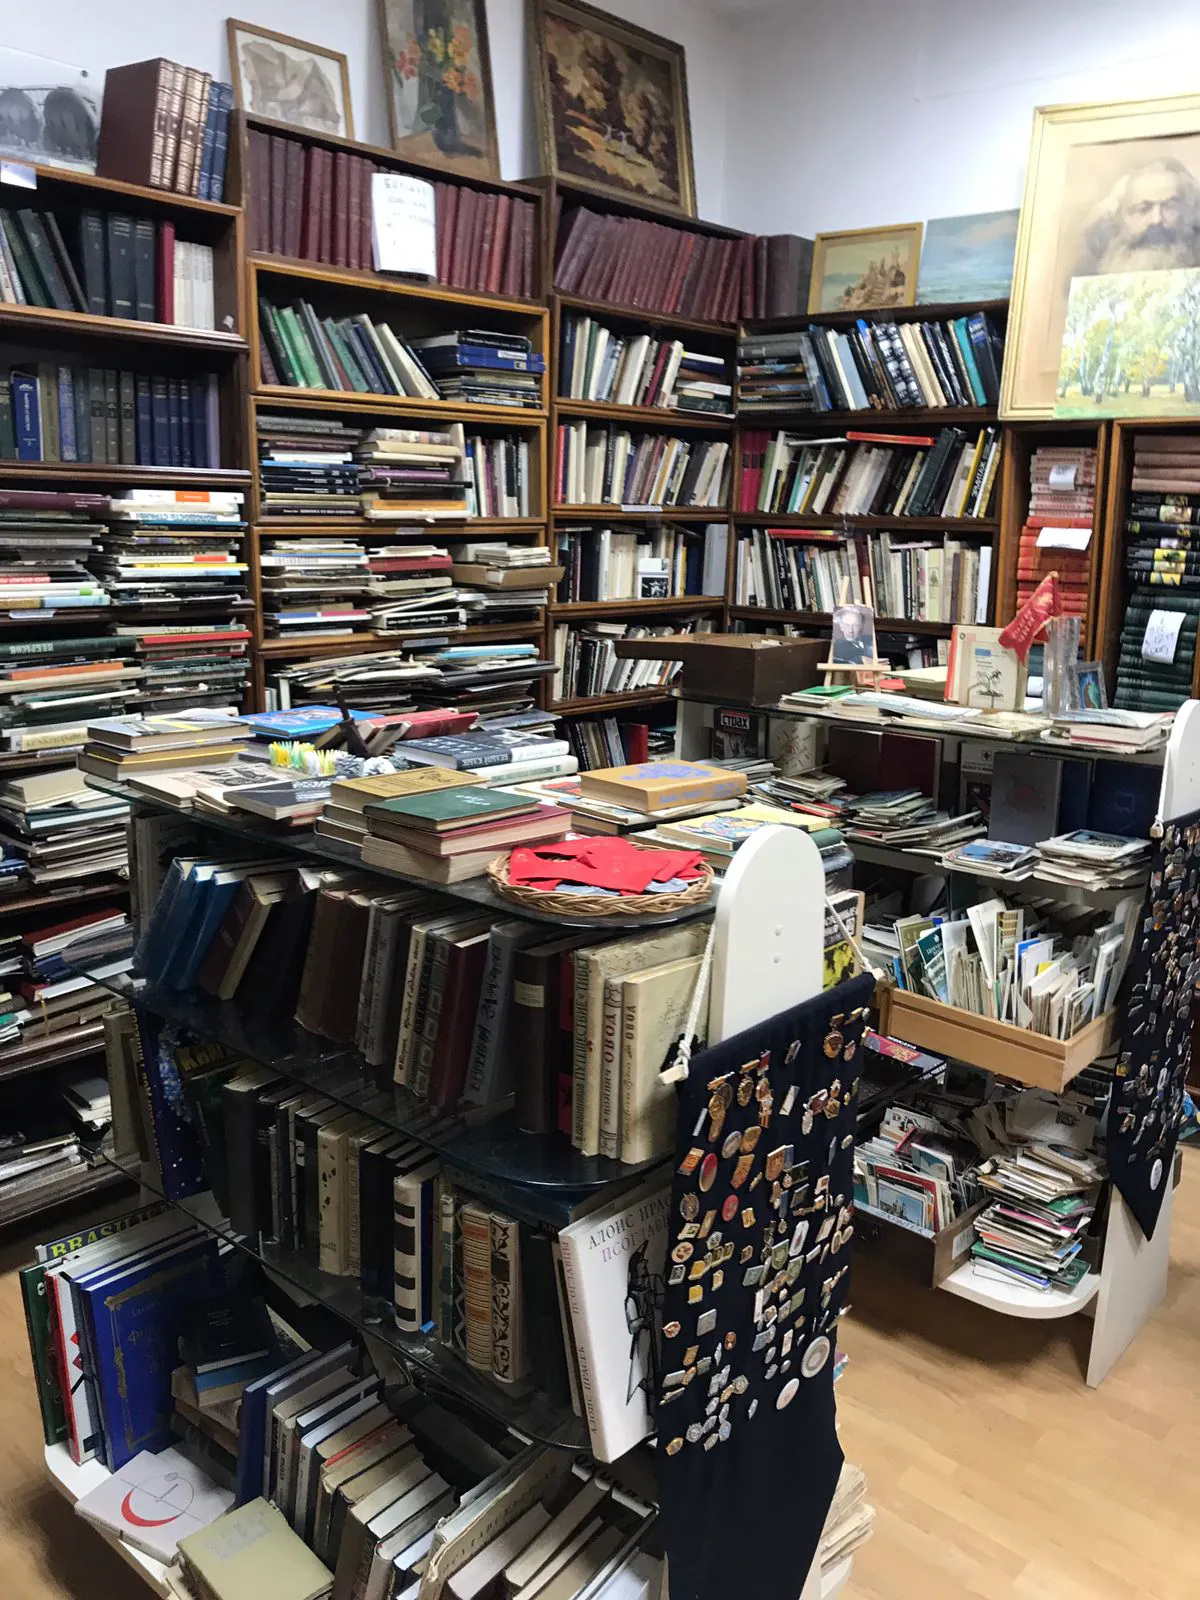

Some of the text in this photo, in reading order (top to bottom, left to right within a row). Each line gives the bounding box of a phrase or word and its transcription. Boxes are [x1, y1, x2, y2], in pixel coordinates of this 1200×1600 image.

[604, 1013, 617, 1063] ОВОД
[625, 1005, 637, 1040] ОВОД
[588, 1214, 635, 1250] АЛОИС
